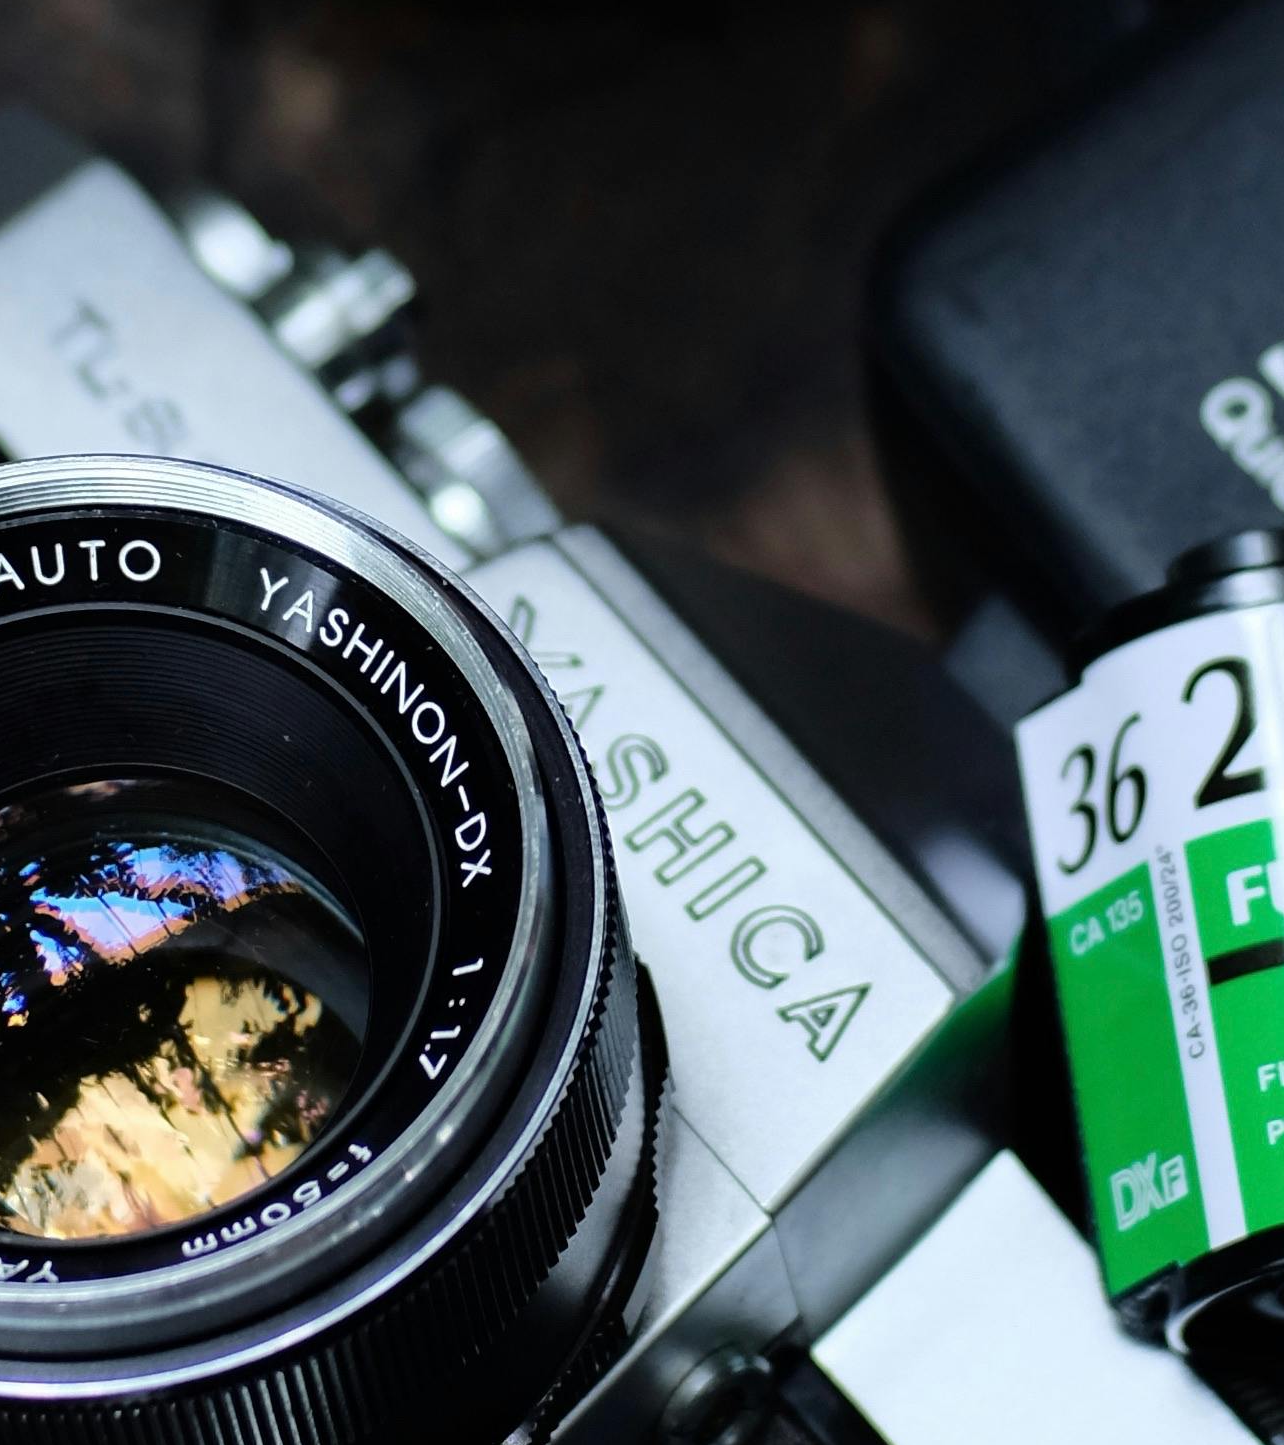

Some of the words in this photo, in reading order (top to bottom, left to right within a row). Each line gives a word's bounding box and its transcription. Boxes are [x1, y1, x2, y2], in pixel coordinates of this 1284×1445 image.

[259, 568, 492, 888] YASHINON-DX
[1057, 713, 1148, 877] 36
[1070, 917, 1105, 956] CA
[1106, 890, 1145, 933] 135
[180, 1142, 375, 1258] f=50mm
